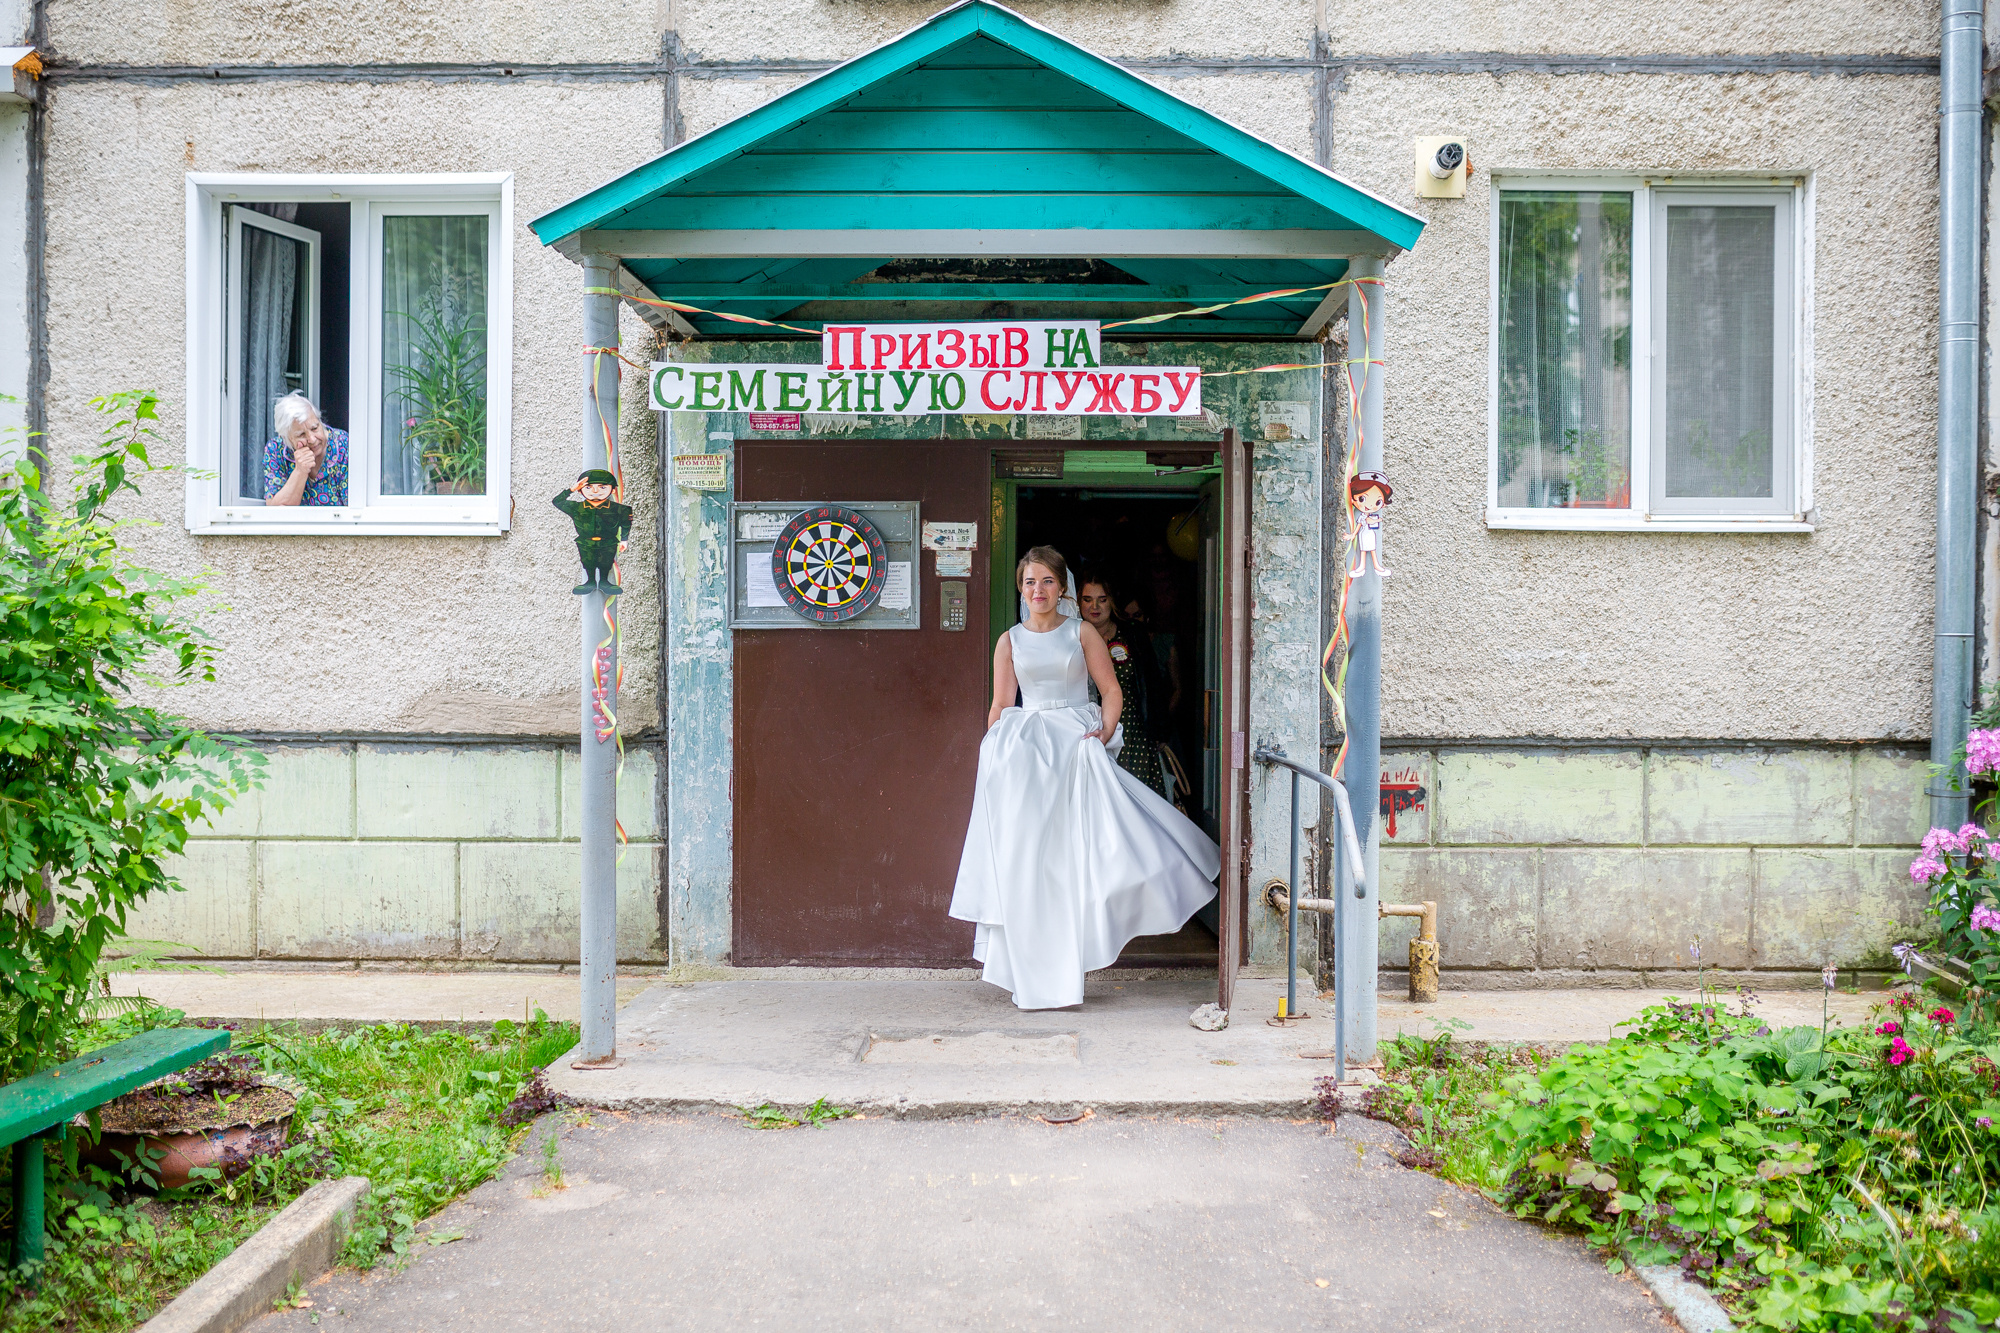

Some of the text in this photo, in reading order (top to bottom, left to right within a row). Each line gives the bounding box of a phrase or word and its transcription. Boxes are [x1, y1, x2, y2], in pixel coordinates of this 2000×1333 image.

[1044, 327, 1099, 368] НА
[653, 366, 1197, 413] СЕМЕЙНУЮ СЛУЖБУ
[804, 513, 811, 522] 5
[818, 508, 829, 518] 20
[837, 509, 842, 517] 1
[850, 514, 859, 524] 18
[790, 521, 800, 531] 12
[780, 535, 788, 543] 9
[871, 538, 881, 548] 13
[775, 549, 784, 558] 14
[876, 569, 885, 578] 10
[778, 582, 787, 590] 8
[787, 594, 797, 605] 16
[861, 598, 868, 607] 2
[800, 604, 808, 612] 7
[846, 606, 855, 616] 17
[816, 610, 825, 620] 19
[834, 611, 840, 620] 3
